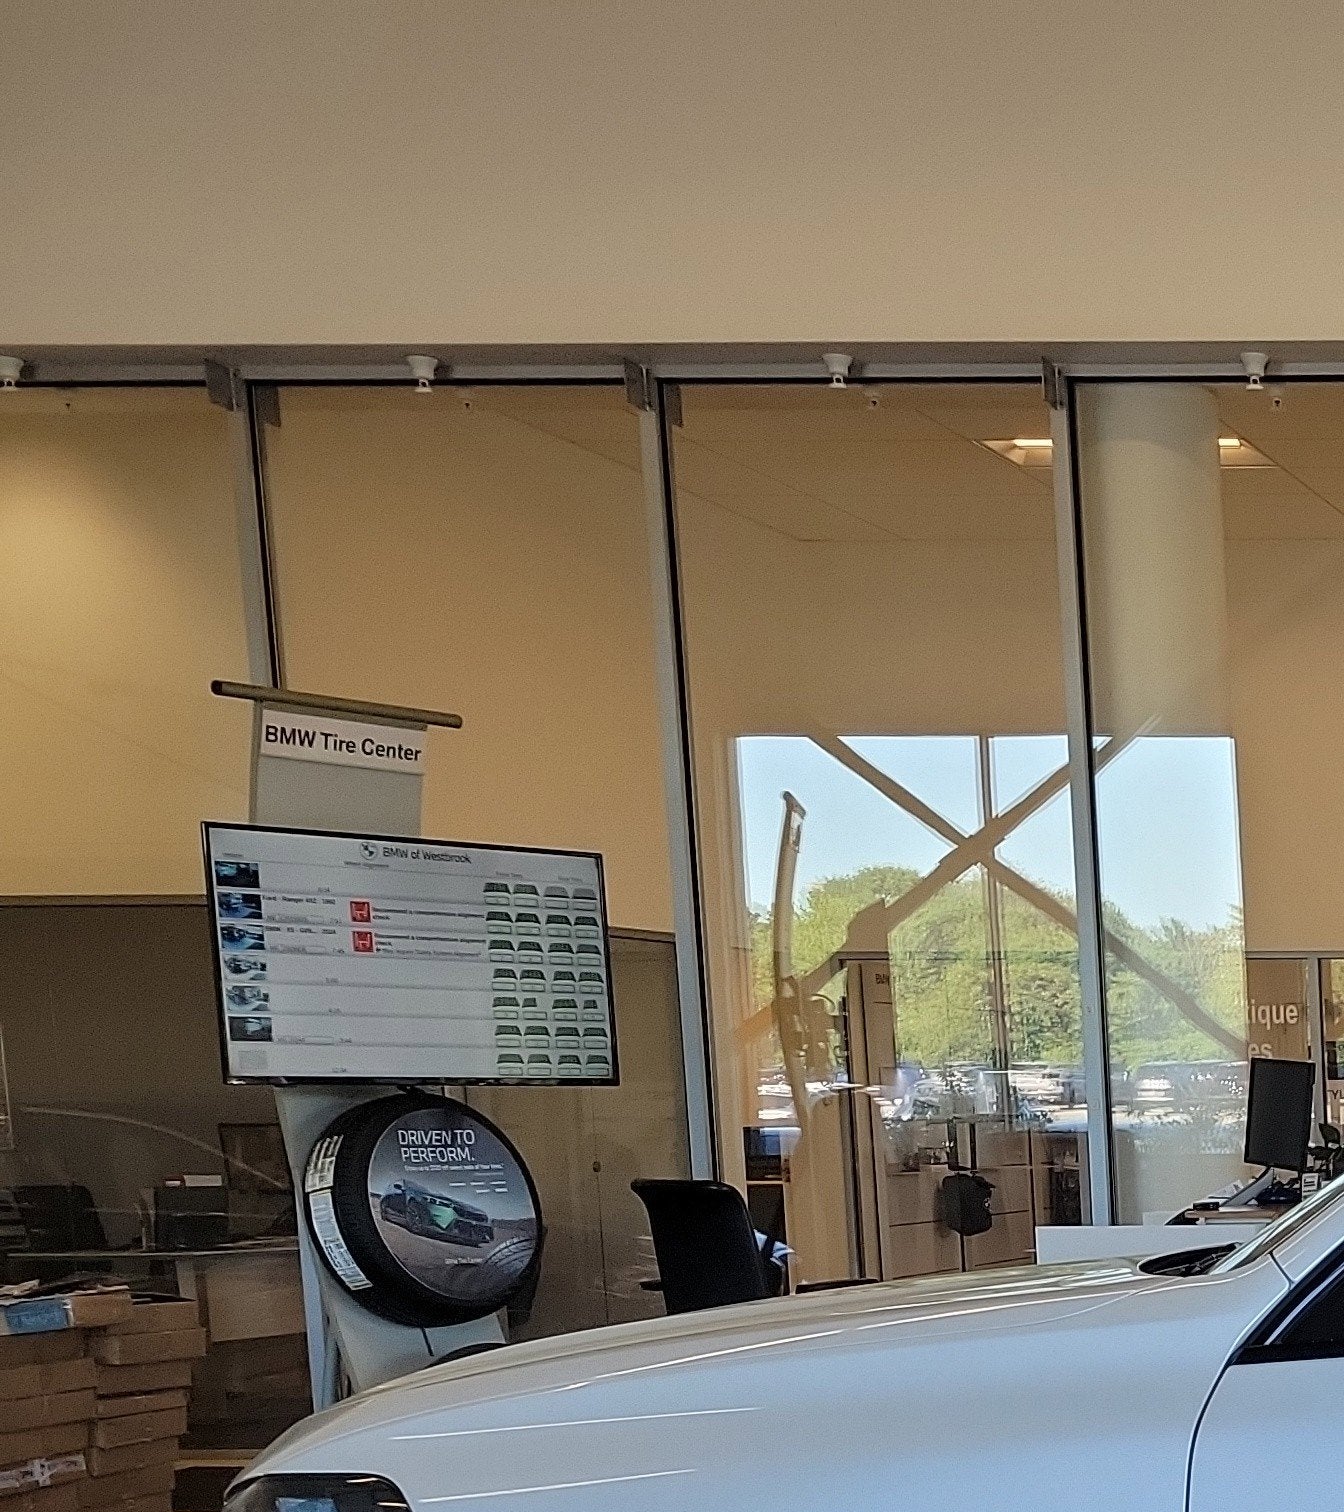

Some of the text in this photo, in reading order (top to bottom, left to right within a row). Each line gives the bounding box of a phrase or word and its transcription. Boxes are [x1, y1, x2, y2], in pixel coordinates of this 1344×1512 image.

[265, 725, 423, 762] BMW Tire Center
[382, 846, 408, 859] BMW
[411, 849, 420, 860] of
[1248, 999, 1299, 1031] ique
[397, 1129, 476, 1146] DRIVEN TO
[400, 1146, 476, 1163] PERFORM.
